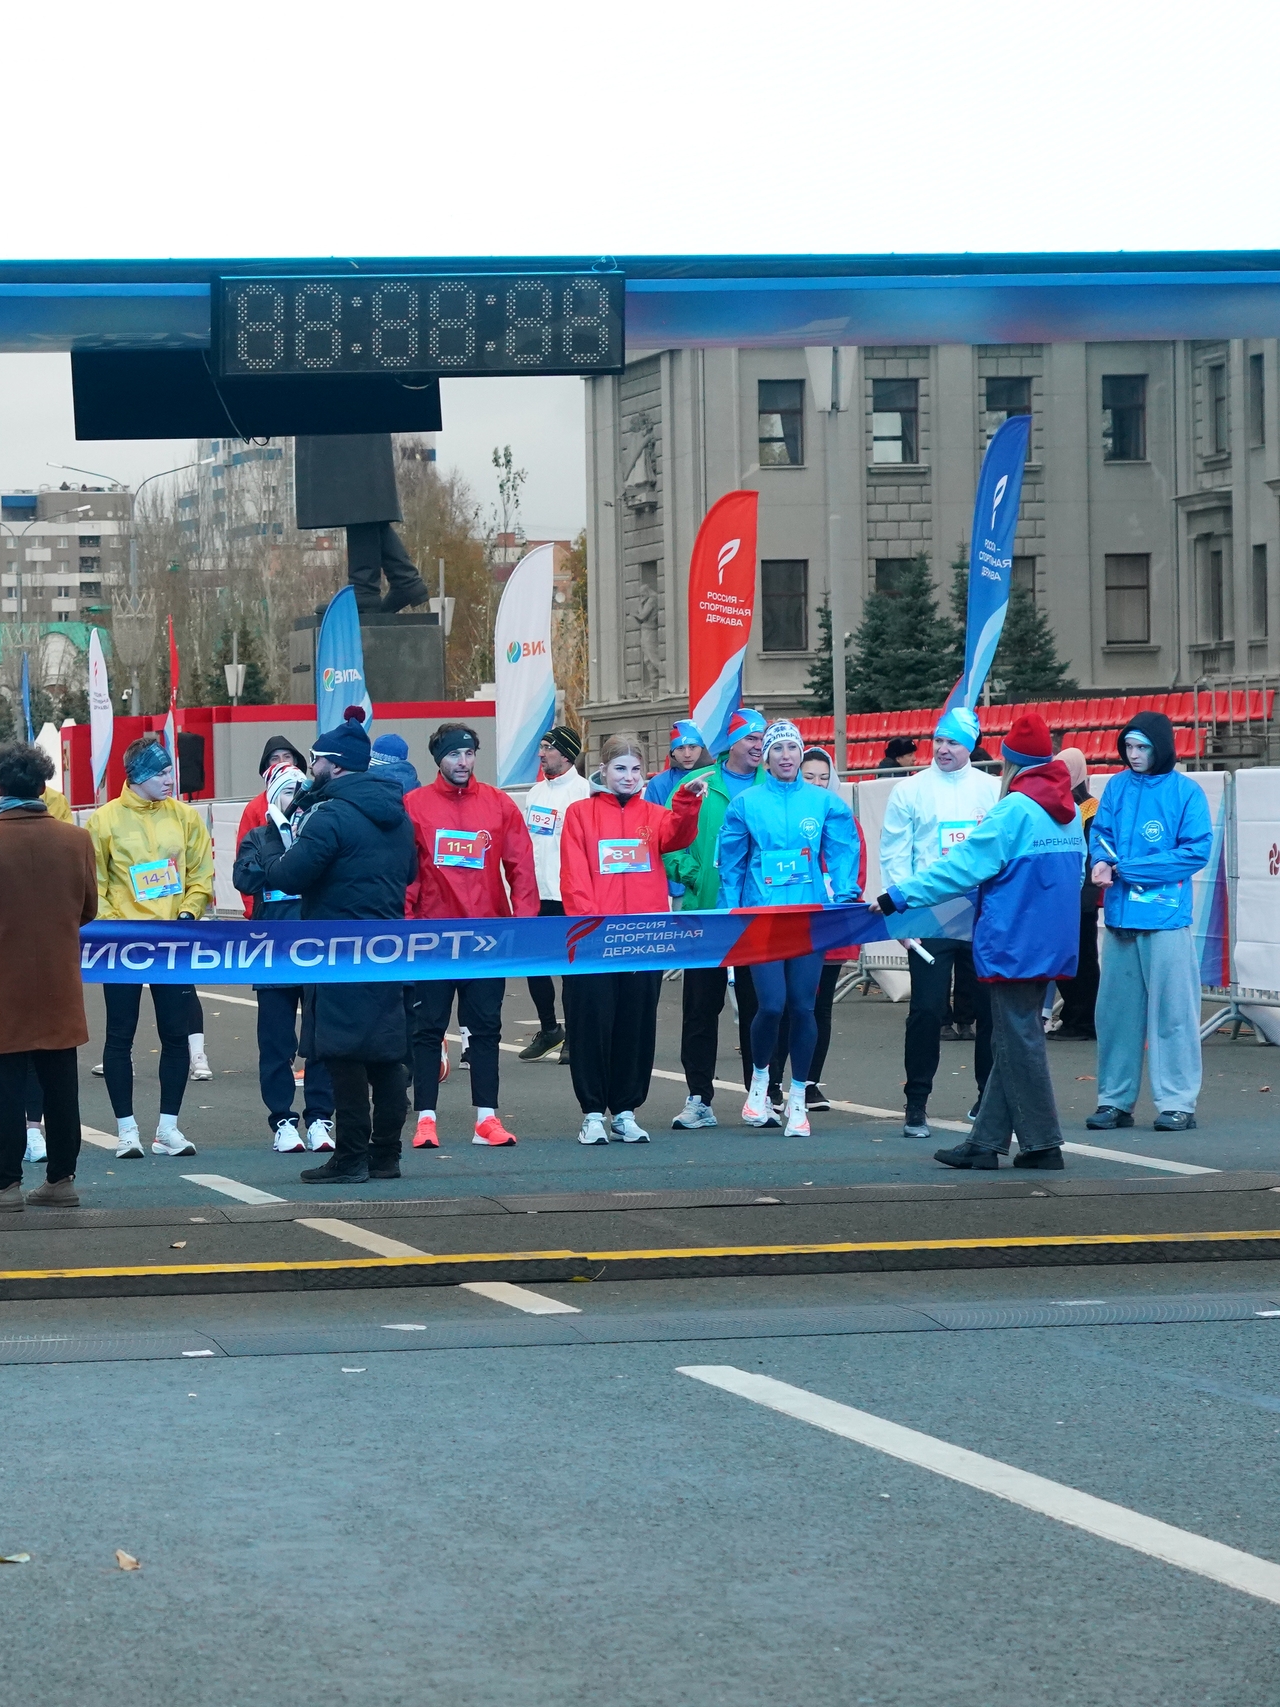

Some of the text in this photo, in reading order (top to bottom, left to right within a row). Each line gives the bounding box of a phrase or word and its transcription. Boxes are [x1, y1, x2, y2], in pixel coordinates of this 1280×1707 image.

[707, 591, 737, 604] РОССИЯ
[699, 601, 751, 616] СПОРТИВНАЯ
[706, 613, 743, 627] ДЕРЖАВА
[334, 667, 363, 685] ВИТА
[532, 814, 551, 826] 19-2
[447, 841, 473, 854] 11-1
[611, 849, 636, 860] 8-1
[776, 860, 796, 872] 1-1
[142, 871, 171, 886] 14-1
[606, 921, 666, 932] РОССИЯ
[604, 929, 704, 944] СПОРТИВНАЯ
[81, 932, 274, 970] ИСТЫЙ
[289, 930, 498, 967] СПОРТ»
[603, 943, 676, 958] ДЕРЖАВА
